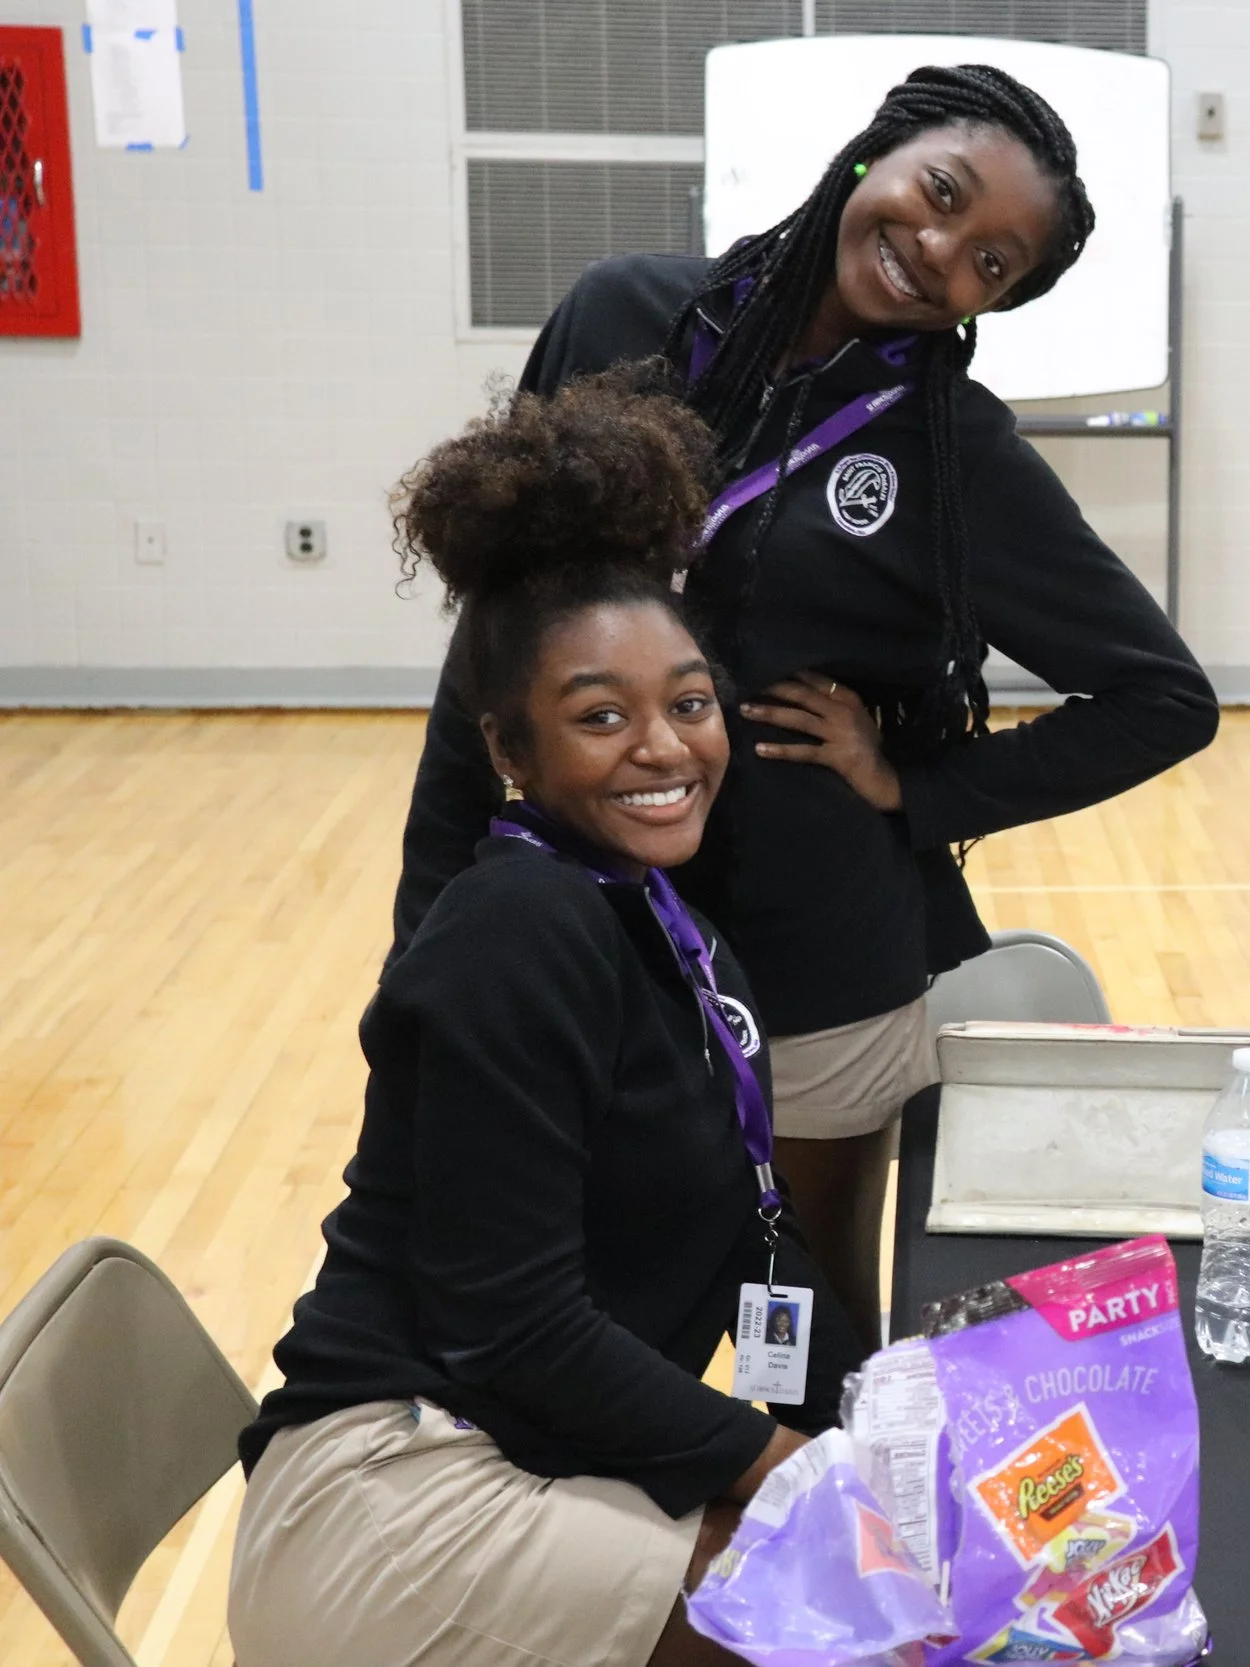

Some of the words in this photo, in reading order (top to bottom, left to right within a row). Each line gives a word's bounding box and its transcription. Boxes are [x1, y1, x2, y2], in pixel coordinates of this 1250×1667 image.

[1215, 1170, 1244, 1185] Water
[754, 1306, 764, 1339] 2022-23
[1068, 1283, 1159, 1333] PARTY
[768, 1361, 789, 1370] Davis
[1024, 1363, 1160, 1404] CHOCOLATE
